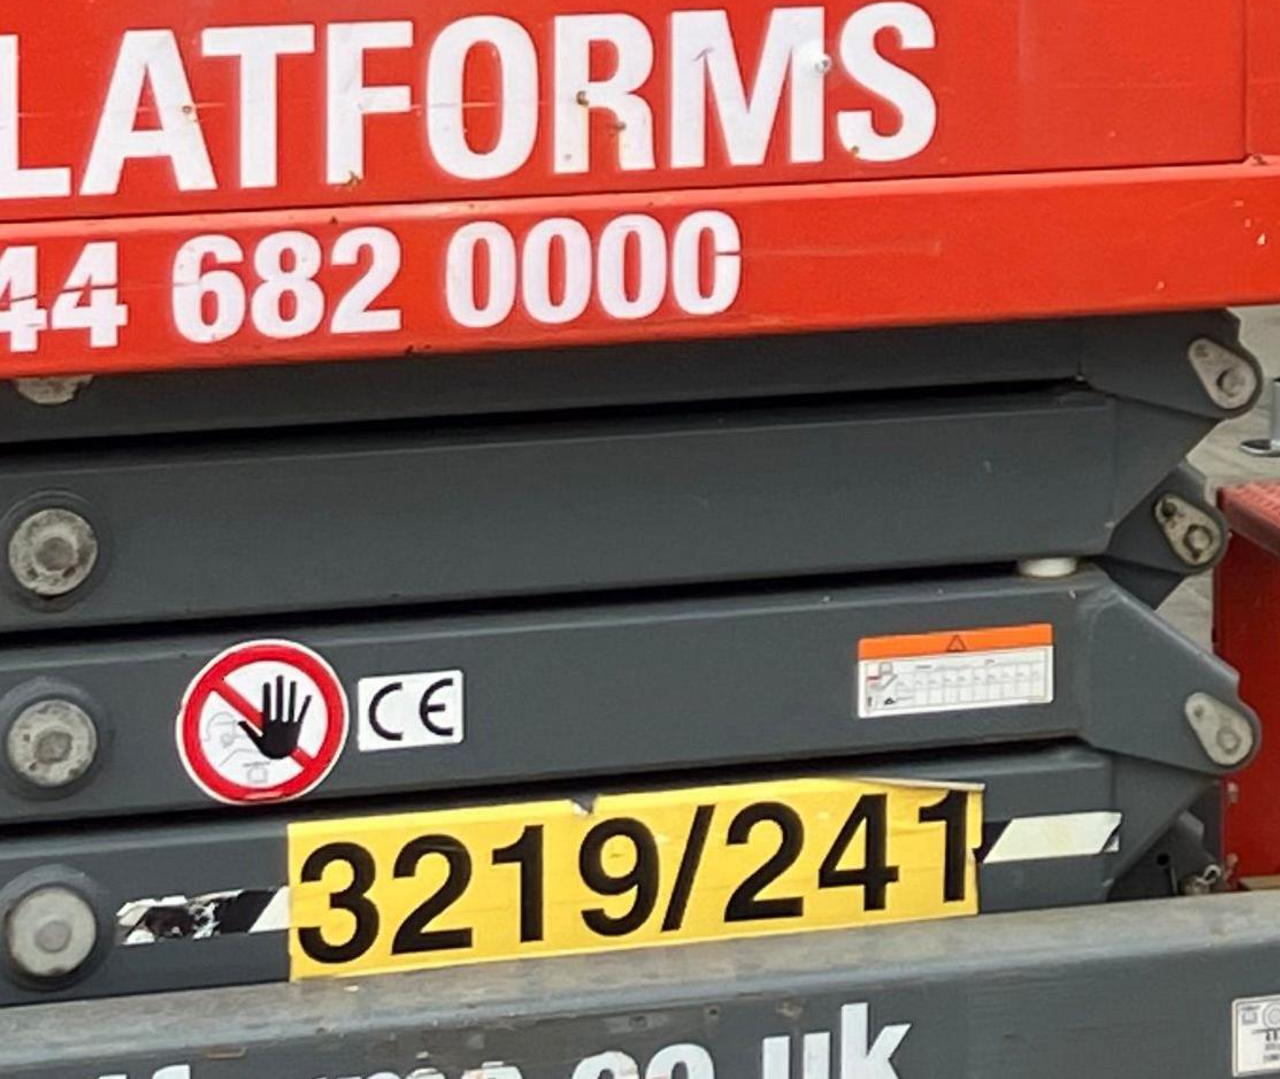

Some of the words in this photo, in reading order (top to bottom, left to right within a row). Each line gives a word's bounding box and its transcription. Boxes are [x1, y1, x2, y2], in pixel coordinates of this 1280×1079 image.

[172, 226, 402, 344] 682
[368, 678, 454, 741] CE
[299, 790, 968, 964] 3219/241
